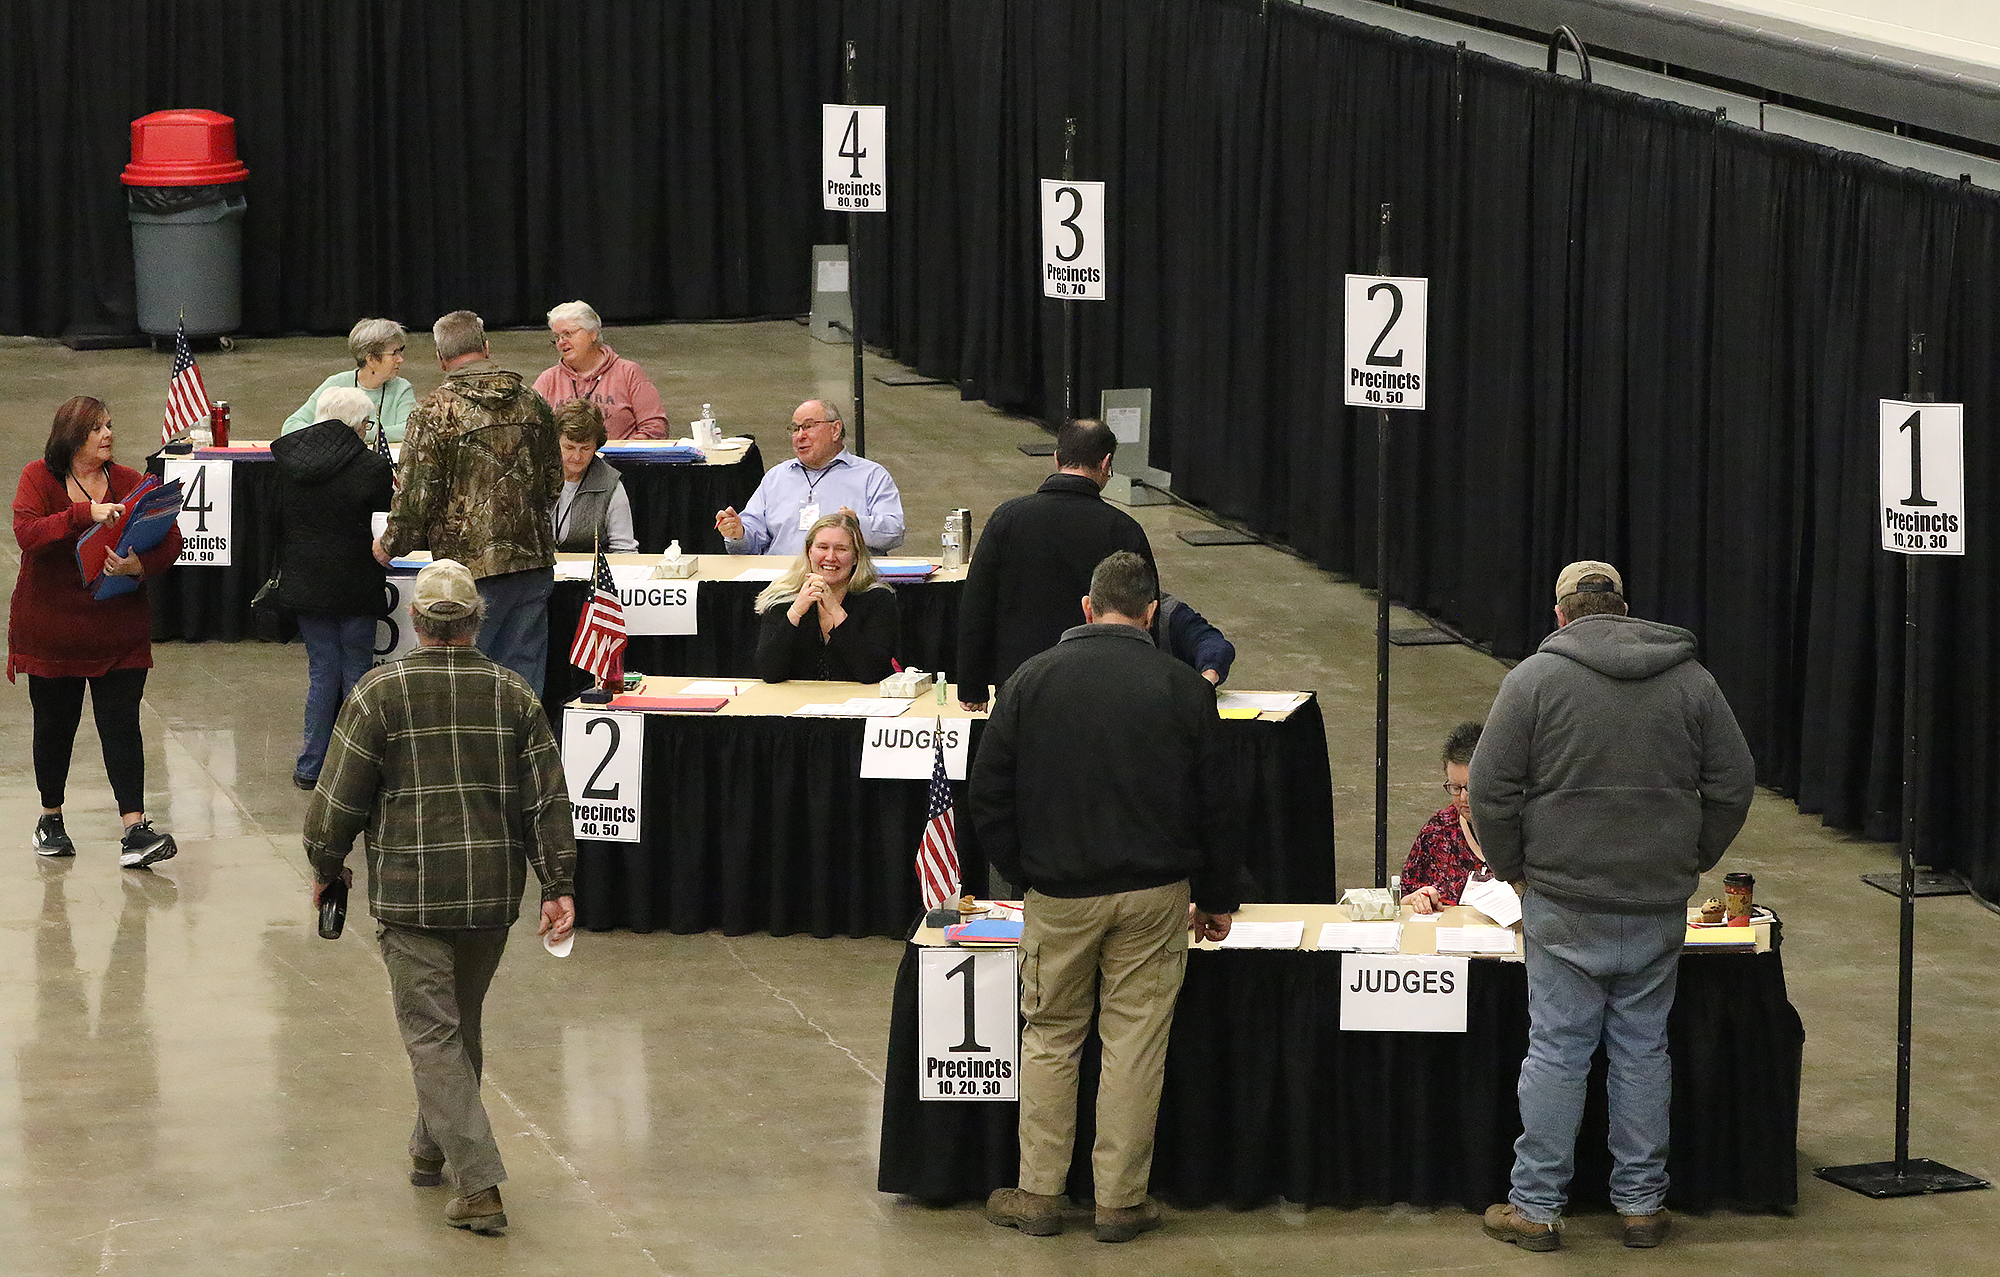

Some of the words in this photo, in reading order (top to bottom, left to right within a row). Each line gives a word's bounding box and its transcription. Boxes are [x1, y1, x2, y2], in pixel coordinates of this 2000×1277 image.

[838, 110, 867, 178] 4
[827, 179, 881, 196] Precincts
[854, 197, 869, 208] 90
[1055, 186, 1085, 262] 3
[1047, 263, 1101, 283] Precincts
[1056, 282, 1069, 296] 60,
[1071, 283, 1086, 295] 70
[1365, 282, 1403, 367] 2
[1350, 367, 1420, 390] Precincts
[1365, 389, 1384, 403] 40,
[1386, 391, 1404, 404] 50
[1899, 410, 1938, 507] 1
[181, 465, 213, 532] 4
[1885, 507, 1959, 533] Precincts
[182, 534, 227, 550] ecincts
[1893, 532, 1906, 548] 10,
[1907, 534, 1926, 549] 20,
[1929, 534, 1948, 549] 30
[180, 551, 197, 562] 80,
[199, 551, 214, 561] 90
[616, 588, 687, 607] UDGES
[871, 728, 959, 749] JUDGES
[581, 716, 621, 801] 2
[580, 823, 600, 836] 40,
[602, 823, 619, 836] 50
[1350, 969, 1455, 994] JUDGES
[944, 954, 992, 1053] 1
[926, 1056, 1012, 1079] Precincts
[936, 1080, 956, 1096] 10,
[958, 1080, 980, 1096] 20,
[982, 1080, 1001, 1095] 30
